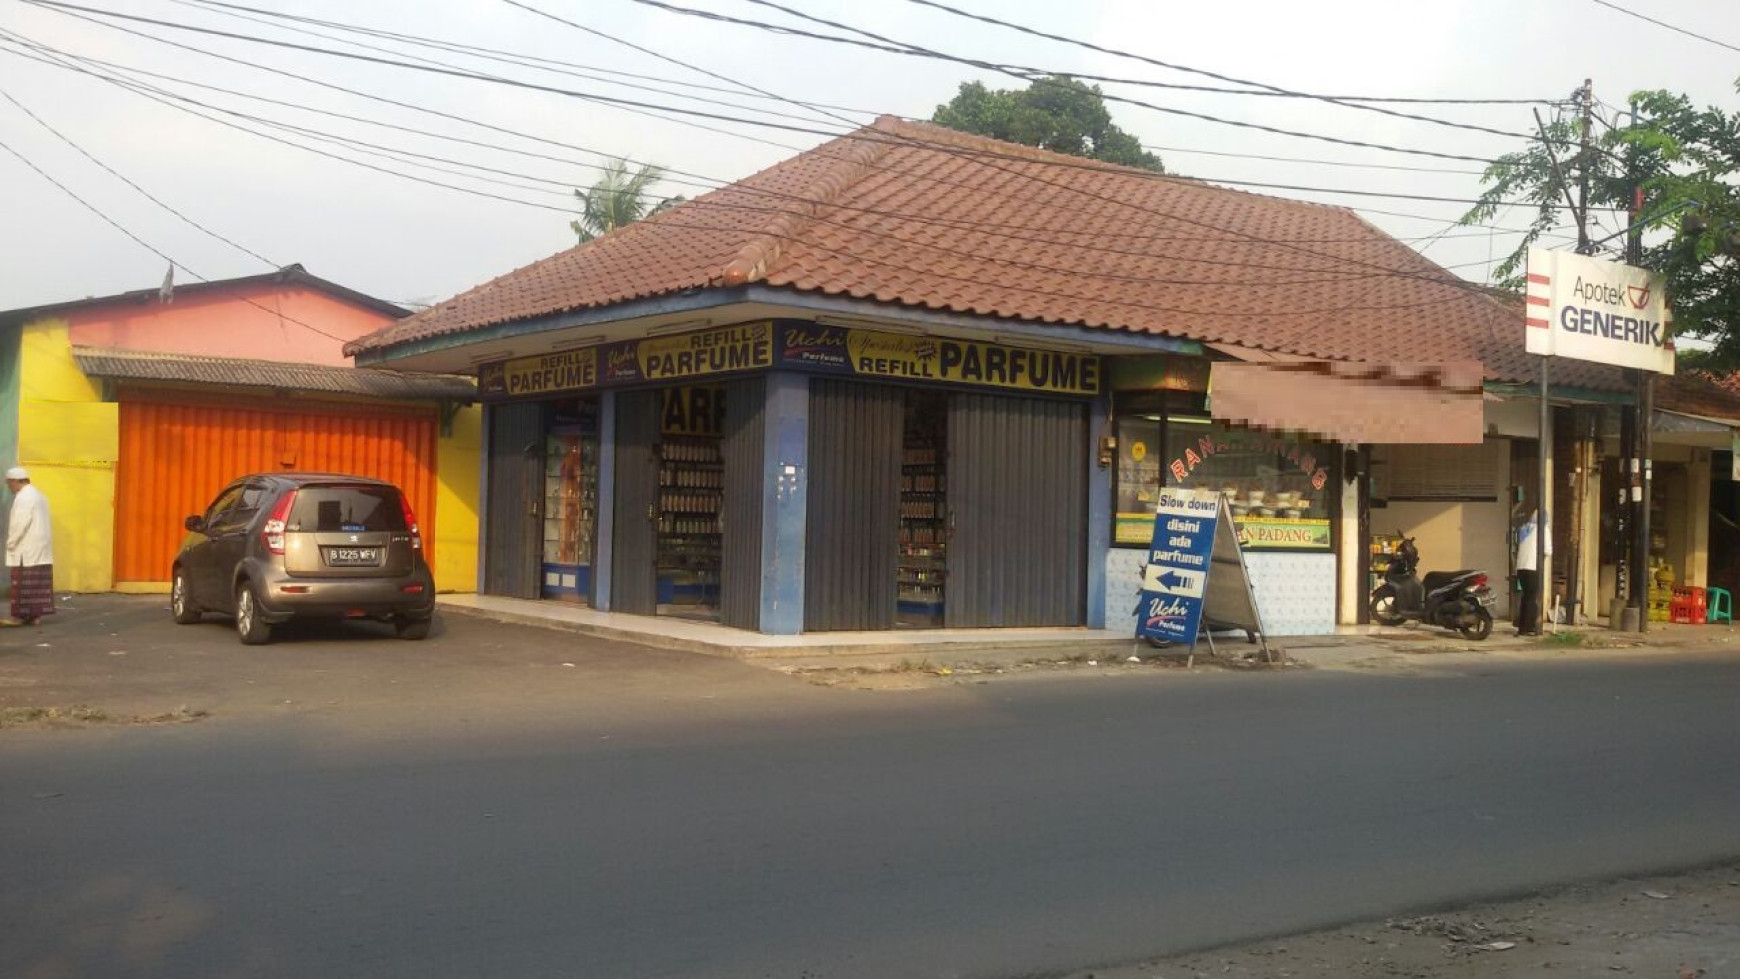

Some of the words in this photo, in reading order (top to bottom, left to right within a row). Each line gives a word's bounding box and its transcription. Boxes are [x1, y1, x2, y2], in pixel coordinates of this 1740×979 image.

[1573, 275, 1627, 307] Apotek
[1560, 305, 1662, 348] GENERIK
[690, 328, 753, 348] REFILL
[784, 328, 846, 348] Uchi
[540, 352, 583, 370] REFILL
[646, 341, 769, 378] PARFUME
[858, 356, 933, 378] REFILL
[939, 341, 1099, 391] PARFUME
[510, 364, 594, 393] PARFUME
[660, 387, 727, 433] ARF
[1160, 494, 1185, 509] Slow
[1187, 497, 1216, 511] down
[1167, 518, 1200, 534] disini
[1258, 527, 1312, 543] PADANG
[1168, 535, 1192, 549] ada
[330, 550, 338, 561] B
[1152, 549, 1204, 566] parfume
